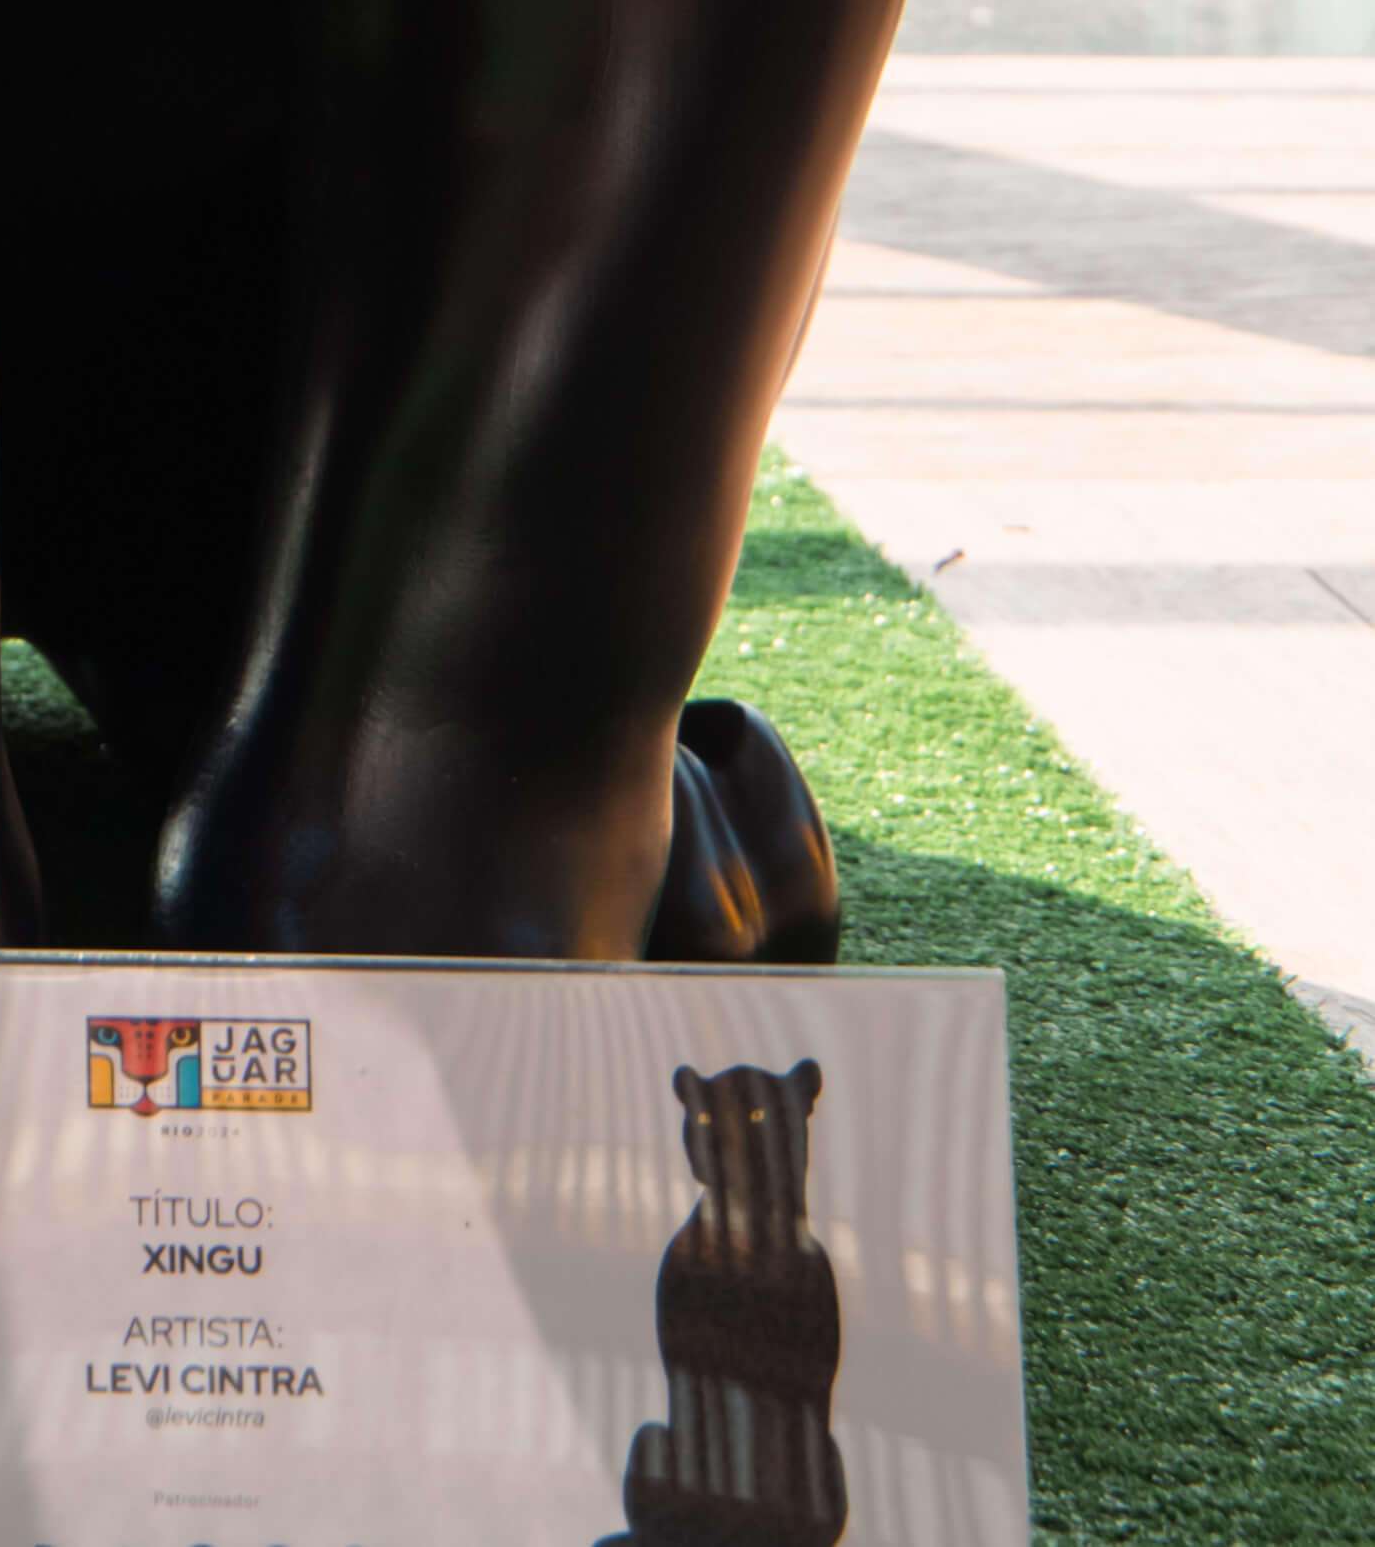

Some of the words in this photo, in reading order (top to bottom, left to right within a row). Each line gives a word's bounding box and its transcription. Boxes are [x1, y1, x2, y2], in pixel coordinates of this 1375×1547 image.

[213, 1025, 297, 1055] JAG
[211, 1091, 299, 1105] PARADE
[129, 1188, 274, 1229] TÍTULO:
[142, 1243, 263, 1276] XINGU
[122, 1315, 284, 1349] ARTISTA:
[86, 1362, 171, 1394] LEVI
[180, 1363, 324, 1397] CINTRA
[145, 1406, 266, 1430] @levicintra
